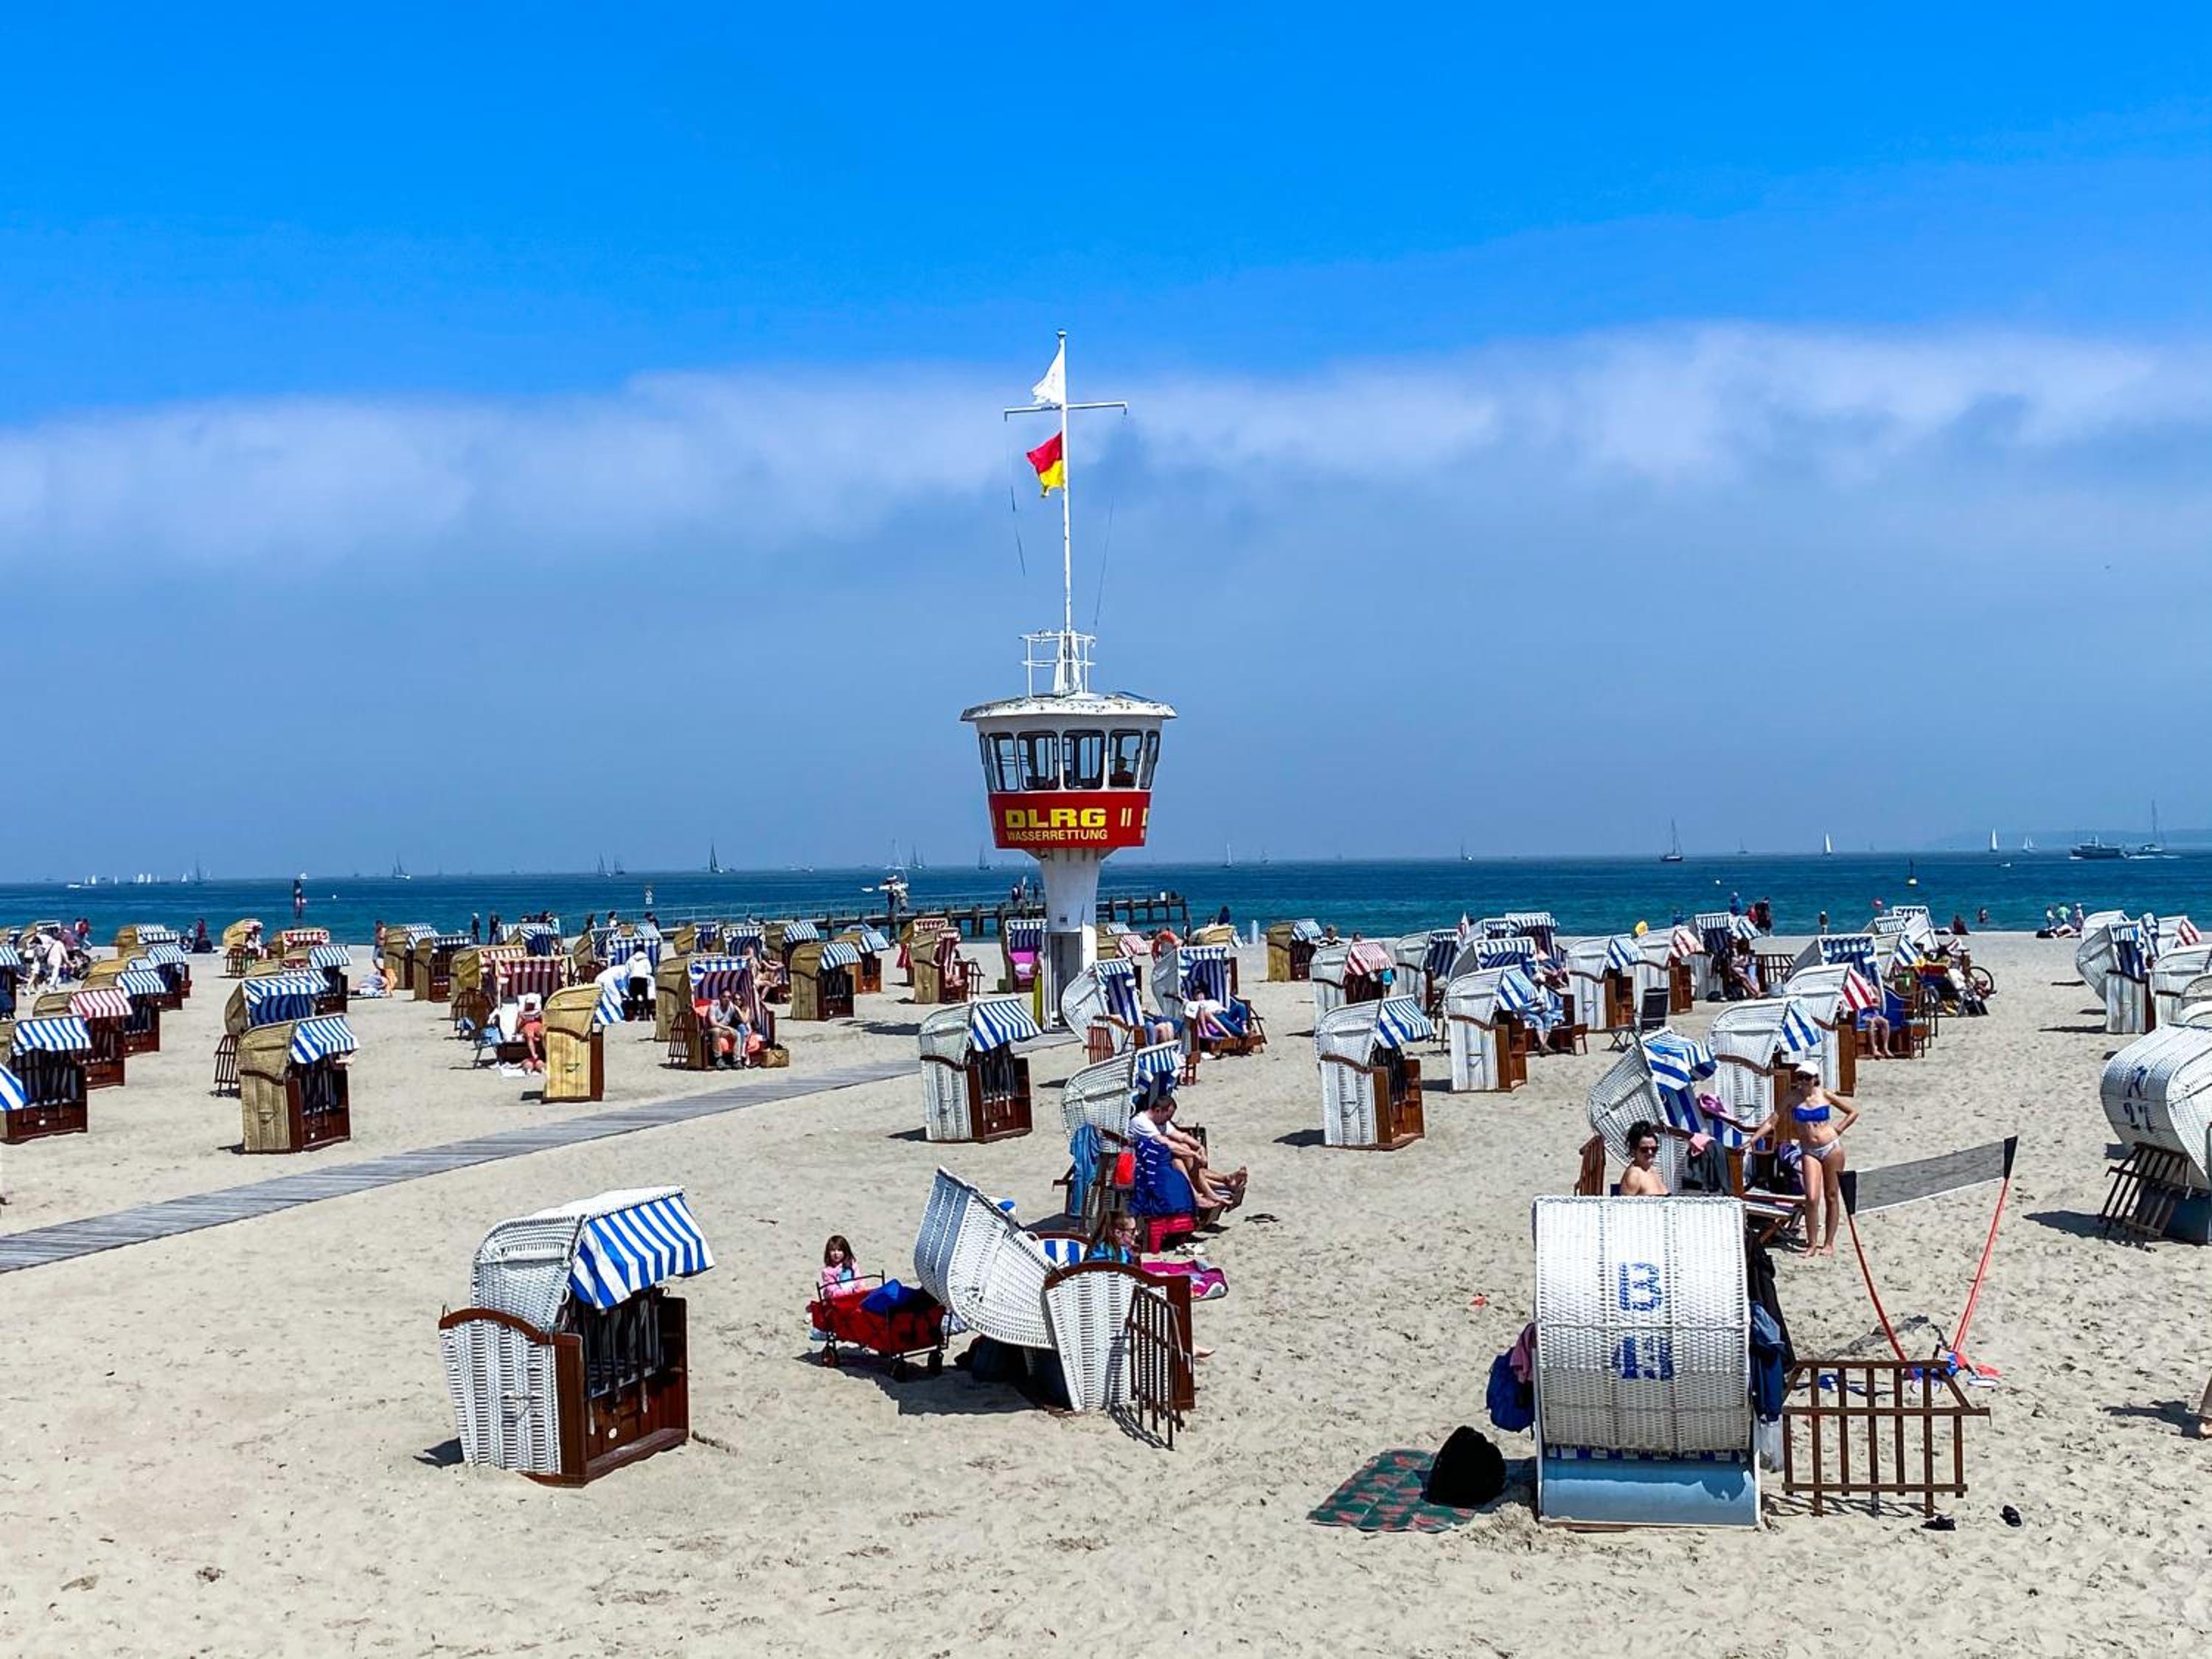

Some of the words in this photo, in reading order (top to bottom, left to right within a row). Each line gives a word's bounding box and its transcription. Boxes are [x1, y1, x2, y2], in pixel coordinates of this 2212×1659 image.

[1006, 808, 1106, 827] DLRG
[1006, 829, 1108, 841] WASSERRETTUNG
[1619, 1262, 1662, 1312] B
